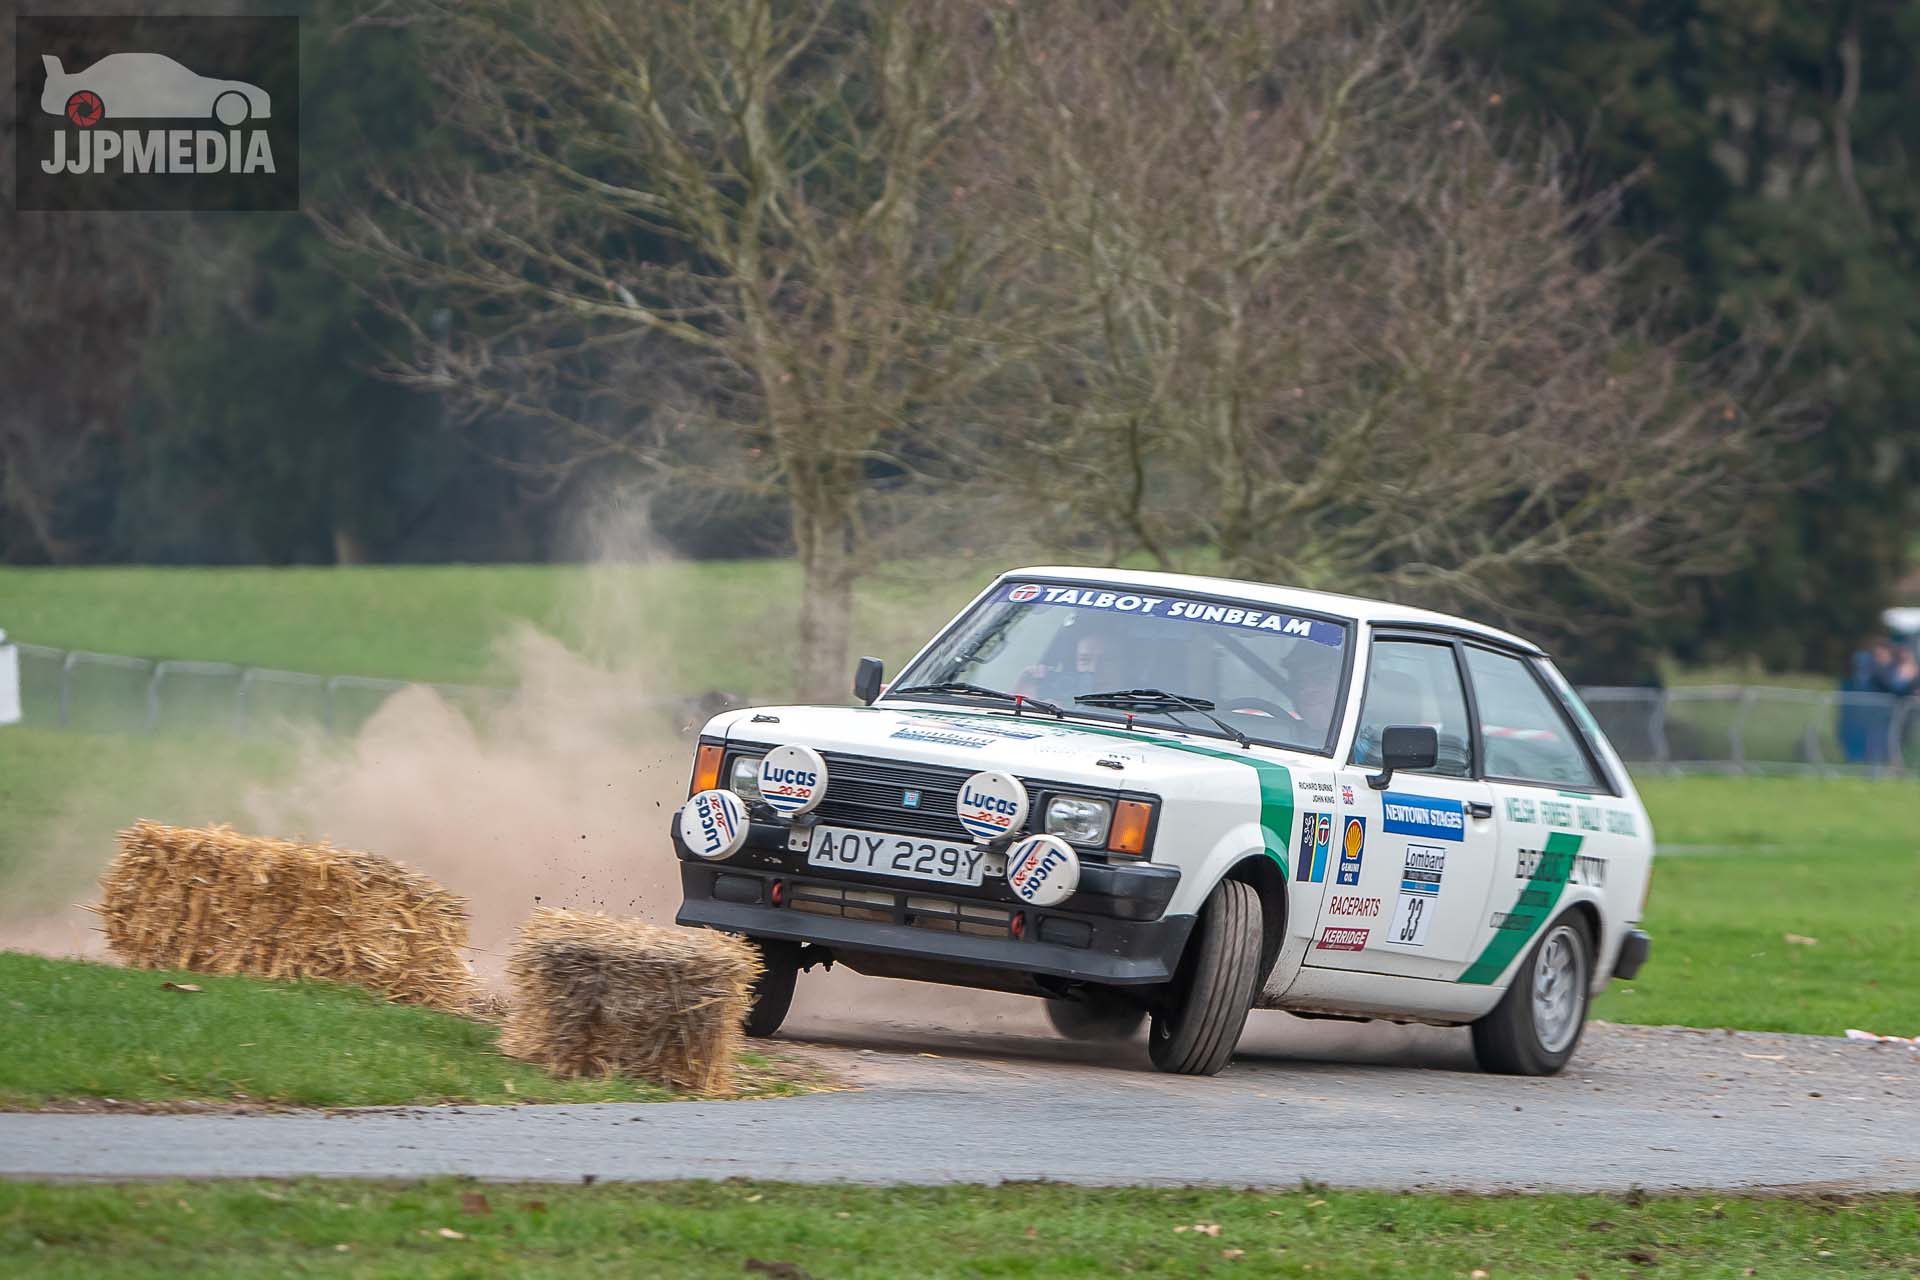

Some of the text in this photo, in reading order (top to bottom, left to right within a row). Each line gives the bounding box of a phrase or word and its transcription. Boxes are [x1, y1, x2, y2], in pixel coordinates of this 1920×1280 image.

[1043, 588, 1312, 637] TALBOT SUNBEAM
[763, 761, 817, 787] Lucas
[778, 785, 812, 798] 20-20
[963, 785, 1017, 816] Lucas
[695, 795, 721, 853] Lucas
[978, 811, 1010, 827] 20-20
[1385, 803, 1463, 829] NEWTOWN STAGES
[815, 832, 984, 880] AOY 229Y
[1405, 847, 1446, 870] Lombard
[1021, 847, 1068, 899] Lucas
[1329, 896, 1381, 917] RACEPARTS
[1400, 898, 1424, 941] 33
[1322, 929, 1368, 945] KERRIDGE
